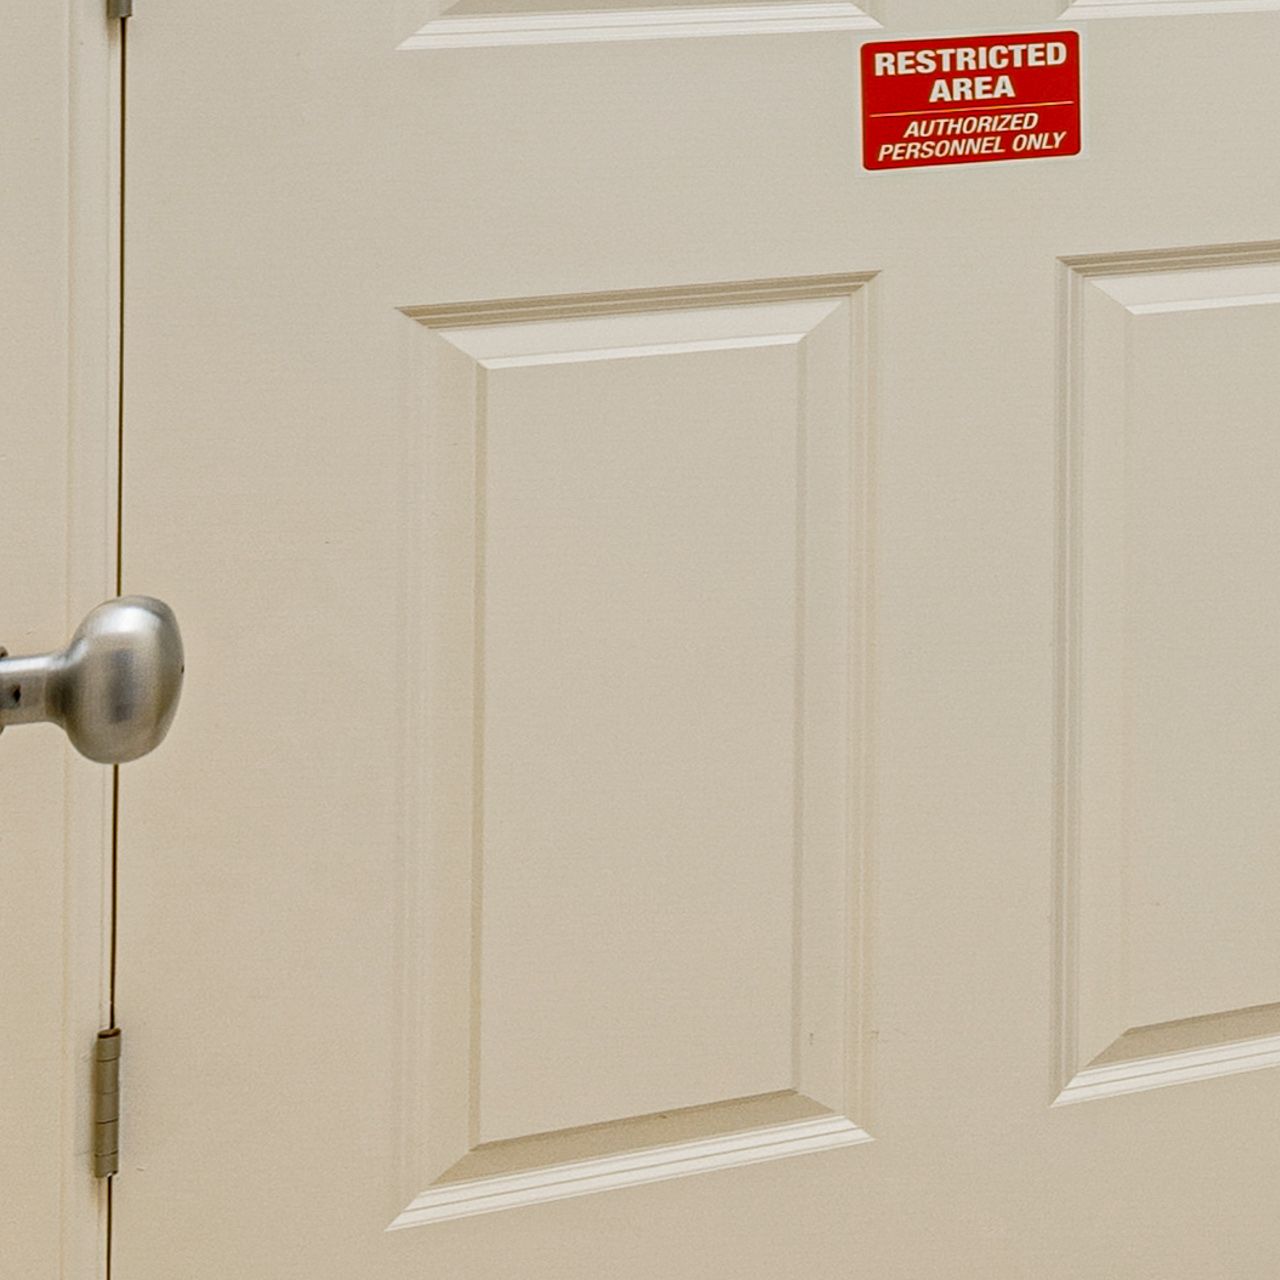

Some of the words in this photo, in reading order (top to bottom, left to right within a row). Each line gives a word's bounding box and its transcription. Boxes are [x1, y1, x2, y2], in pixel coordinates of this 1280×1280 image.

[874, 41, 1067, 76] RESTRICTED
[929, 75, 1016, 103] AREA
[903, 112, 1038, 138] AUTHORIZED
[878, 136, 1005, 162] PERSONNEL
[1012, 131, 1067, 152] ONLY
